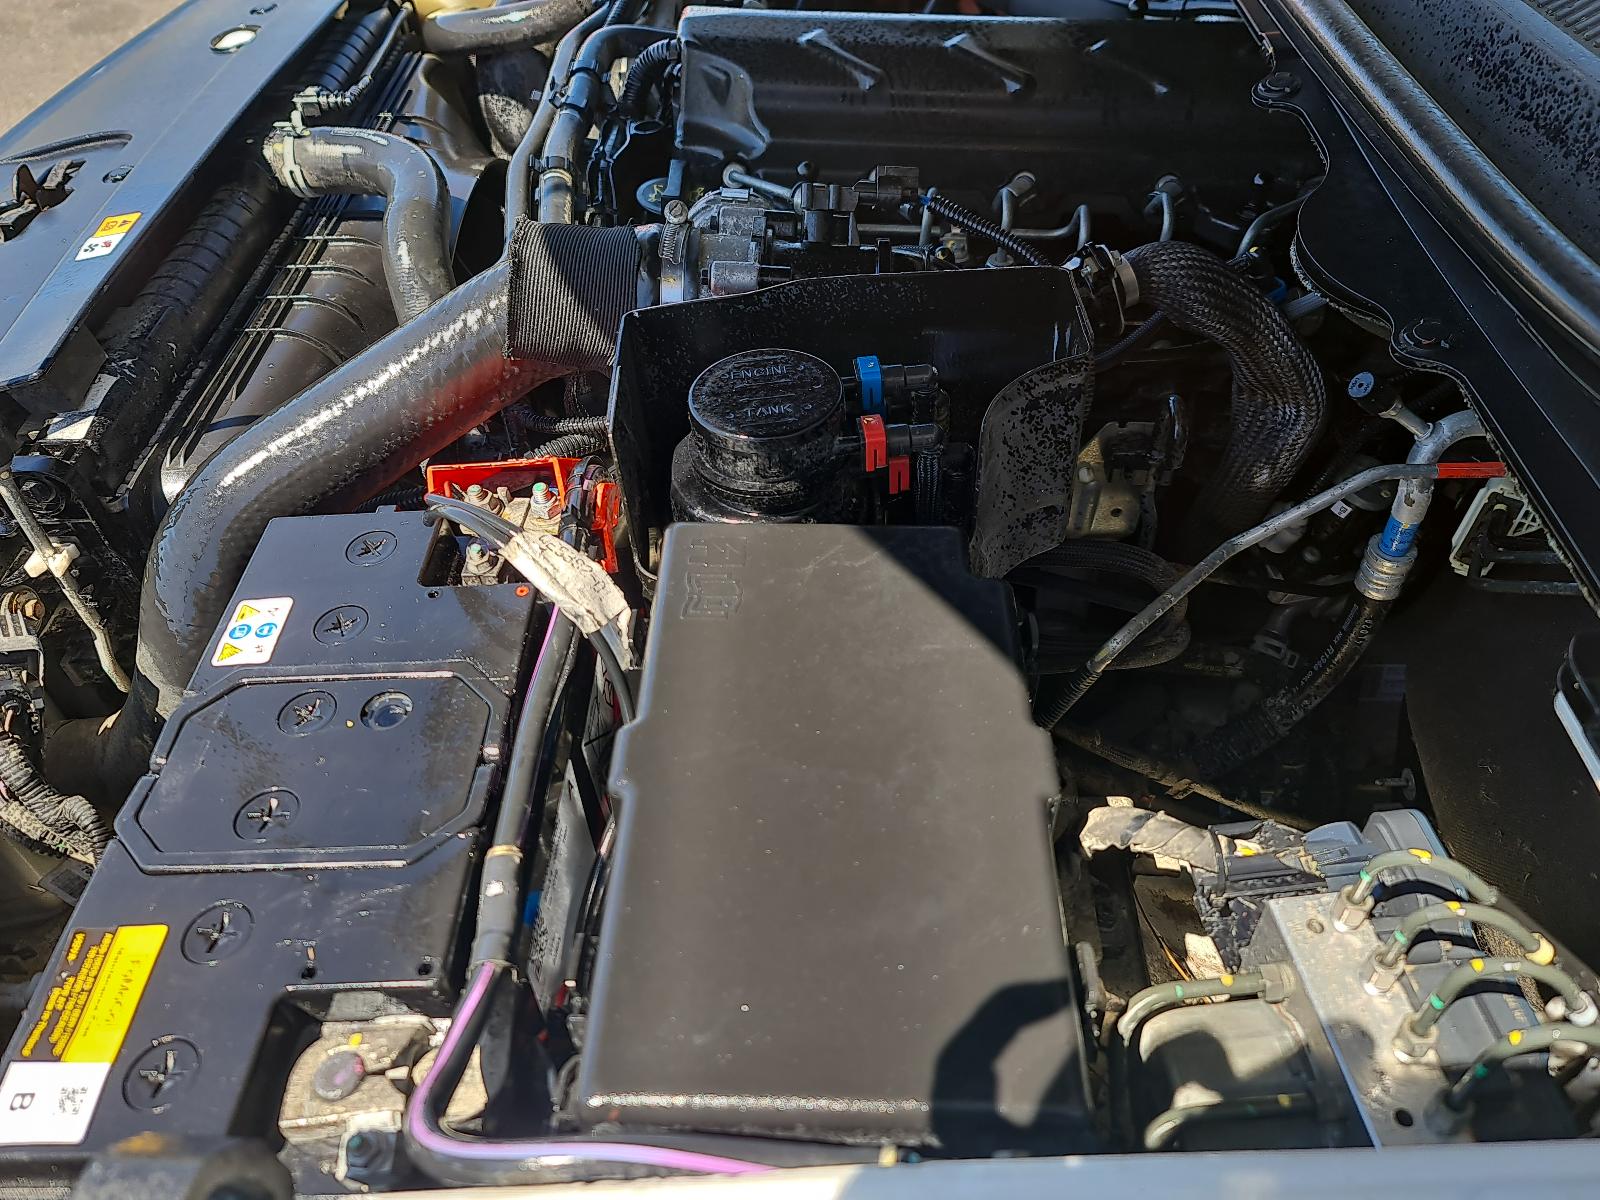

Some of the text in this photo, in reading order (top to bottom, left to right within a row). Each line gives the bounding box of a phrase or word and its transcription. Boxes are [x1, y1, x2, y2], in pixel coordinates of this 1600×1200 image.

[730, 364, 791, 380] ENGINE
[743, 402, 793, 418] TANK
[9, 1092, 36, 1111] B
